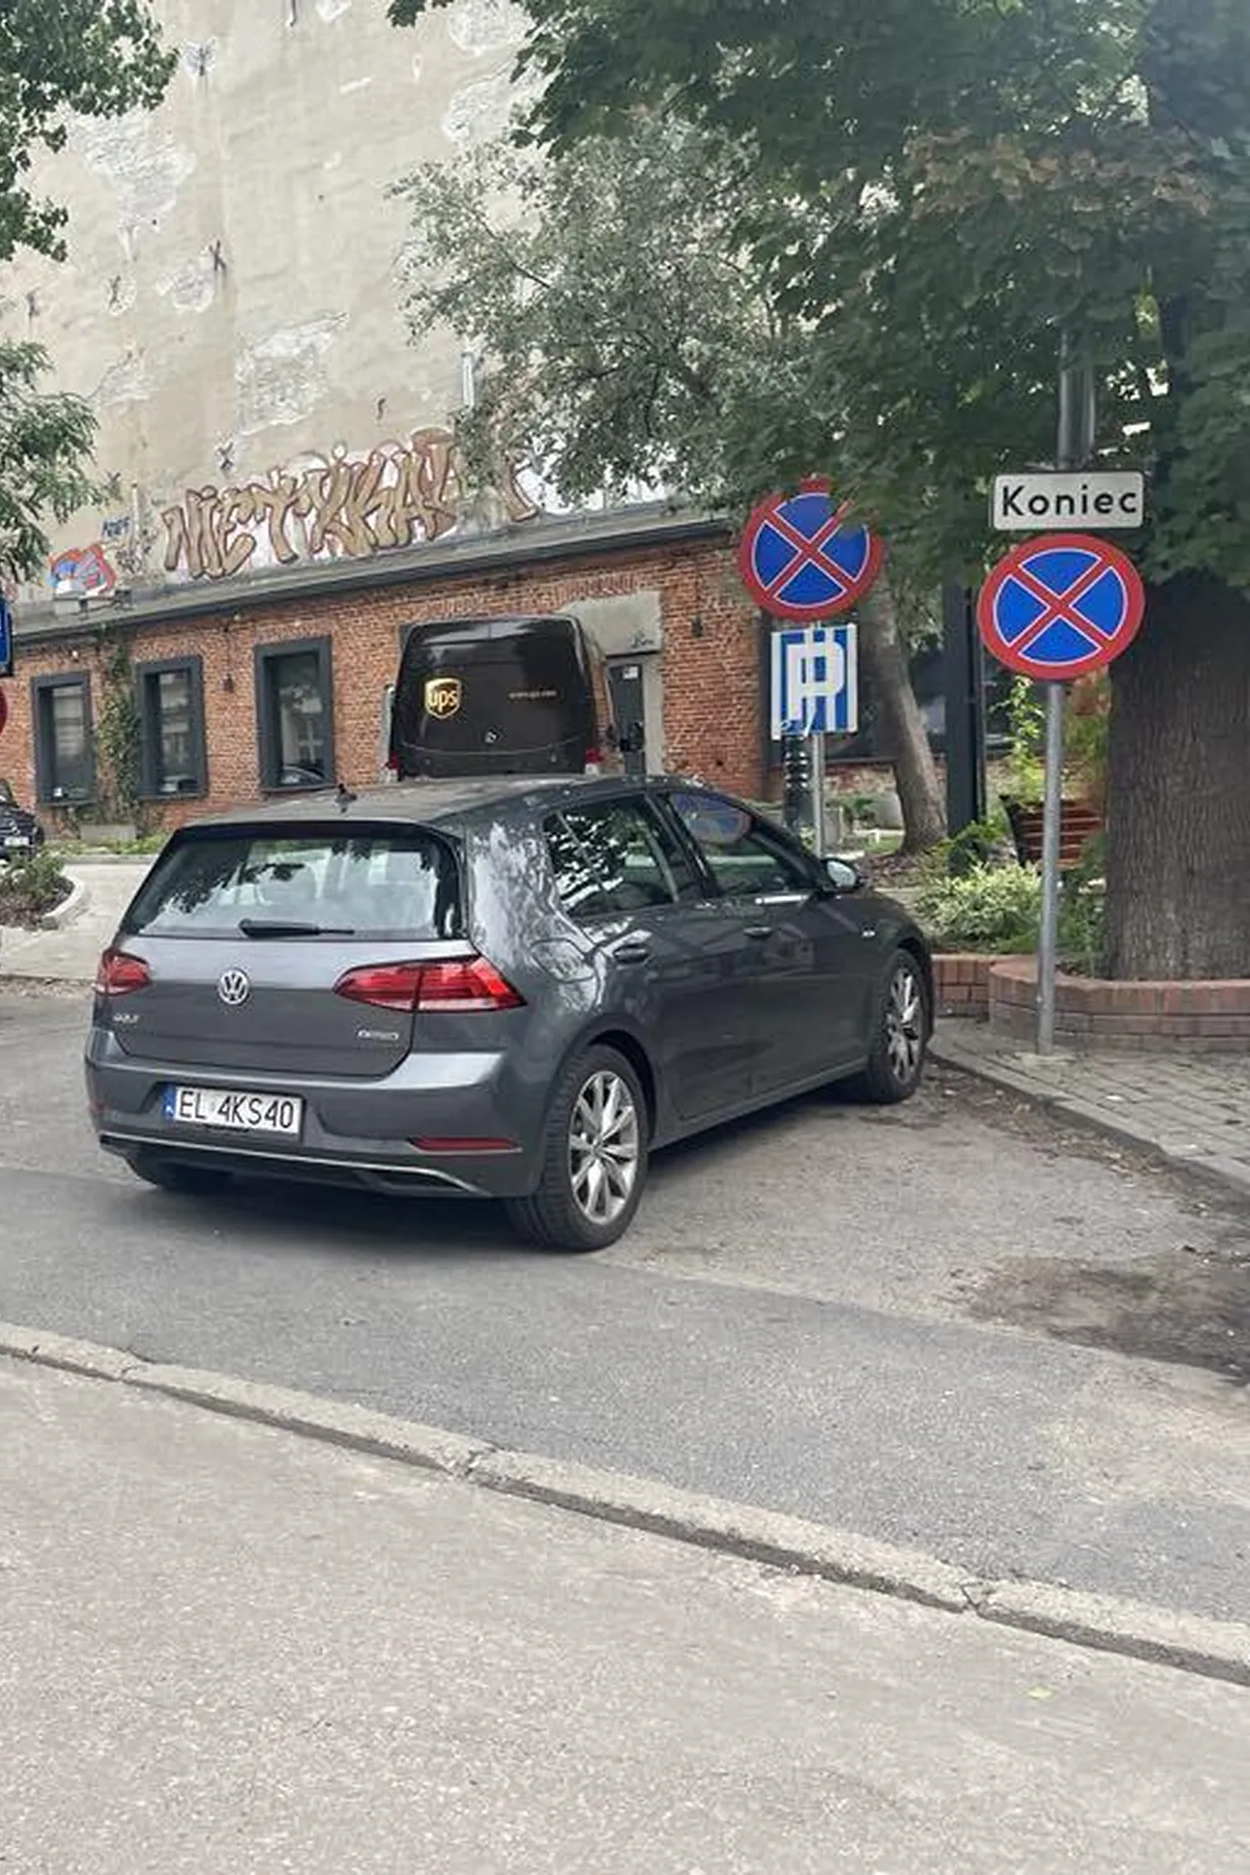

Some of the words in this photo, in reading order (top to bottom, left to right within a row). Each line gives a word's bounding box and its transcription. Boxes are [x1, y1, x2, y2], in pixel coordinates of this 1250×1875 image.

[1003, 484, 1137, 516] Koniec
[429, 690, 457, 713] ups
[180, 1090, 206, 1119] EL
[217, 1094, 294, 1129] 4KS40
